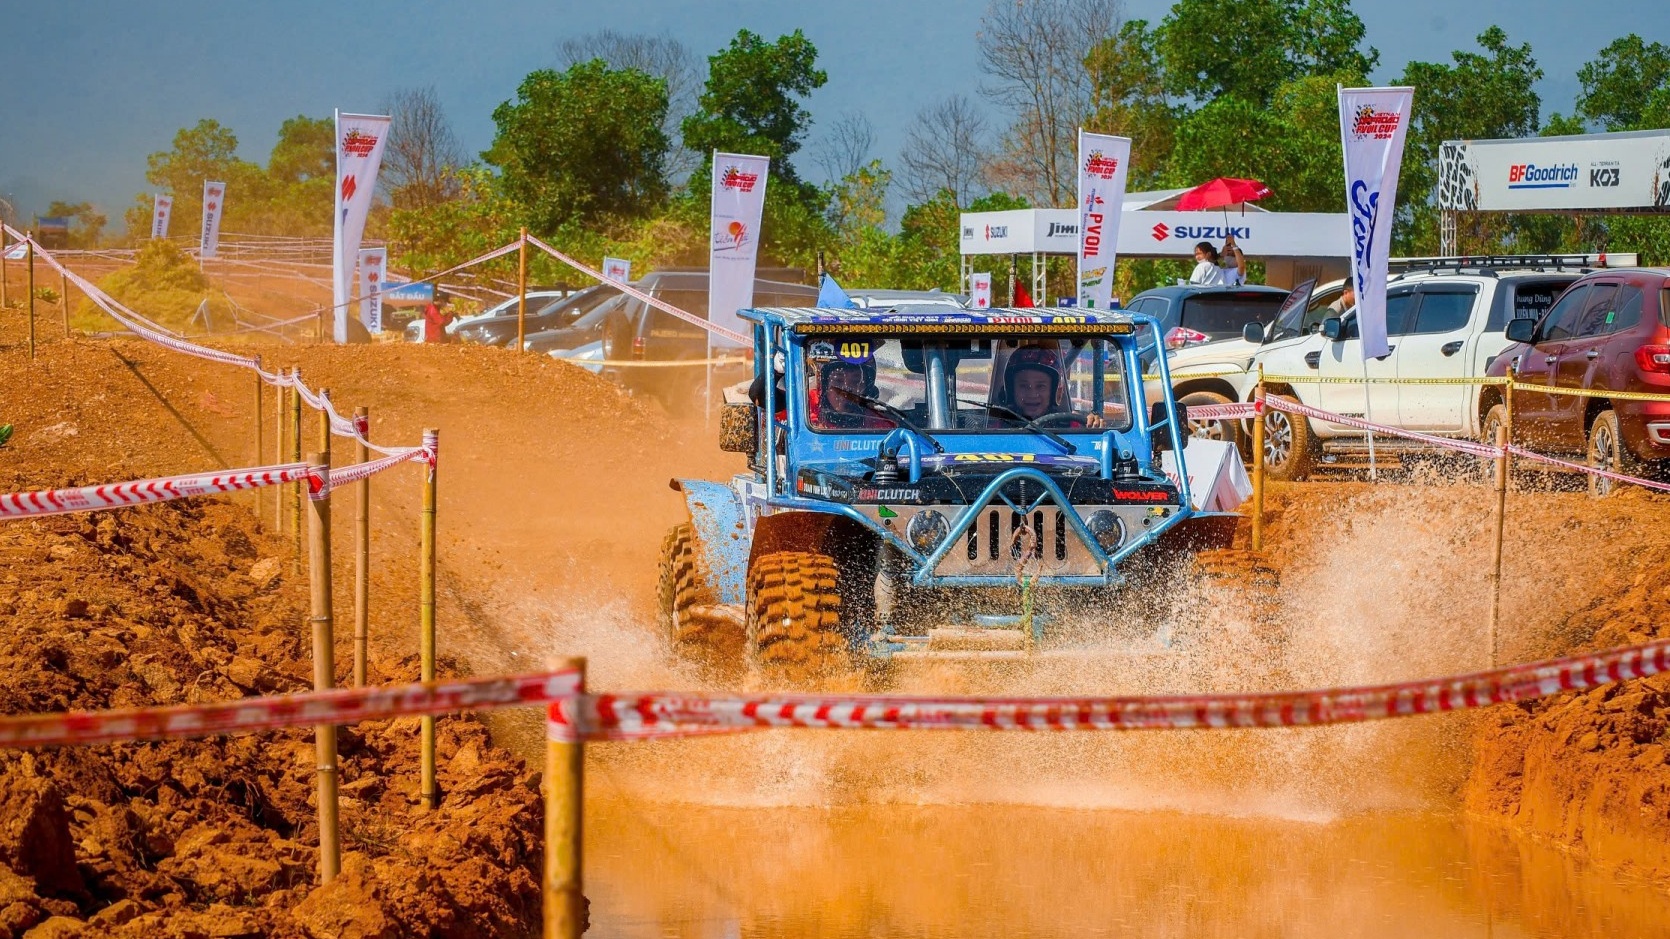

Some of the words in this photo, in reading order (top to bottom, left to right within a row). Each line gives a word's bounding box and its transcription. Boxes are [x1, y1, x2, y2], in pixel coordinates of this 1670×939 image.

[1509, 164, 1578, 182] BFGoodrich
[1590, 168, 1620, 187] KO3
[203, 212, 214, 250] SUZUKI
[990, 226, 1008, 238] SUZUKI
[1084, 214, 1103, 259] PVOIL
[1174, 226, 1250, 239] SUZUKI
[370, 285, 378, 328] SUZUKI
[840, 342, 869, 358] 407
[858, 489, 920, 500] UNICLUTCH
[1112, 488, 1168, 500] WOLVER
